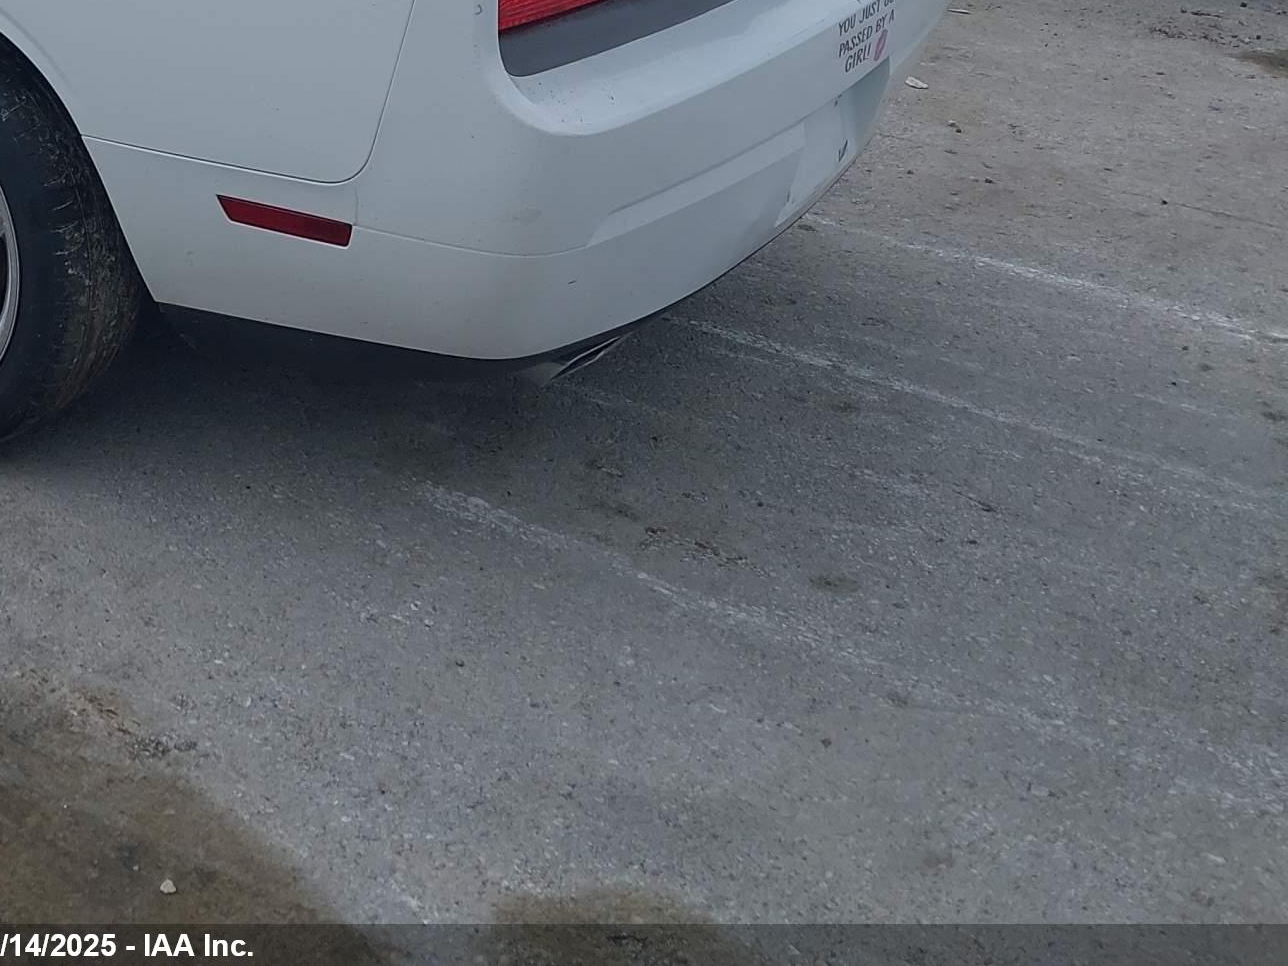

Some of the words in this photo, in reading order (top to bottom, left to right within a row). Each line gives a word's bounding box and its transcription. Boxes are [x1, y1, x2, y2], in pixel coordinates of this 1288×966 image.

[838, 13, 857, 37] YOU
[838, 25, 873, 59] PASSED
[875, 13, 888, 33] BY
[889, 8, 895, 24] A
